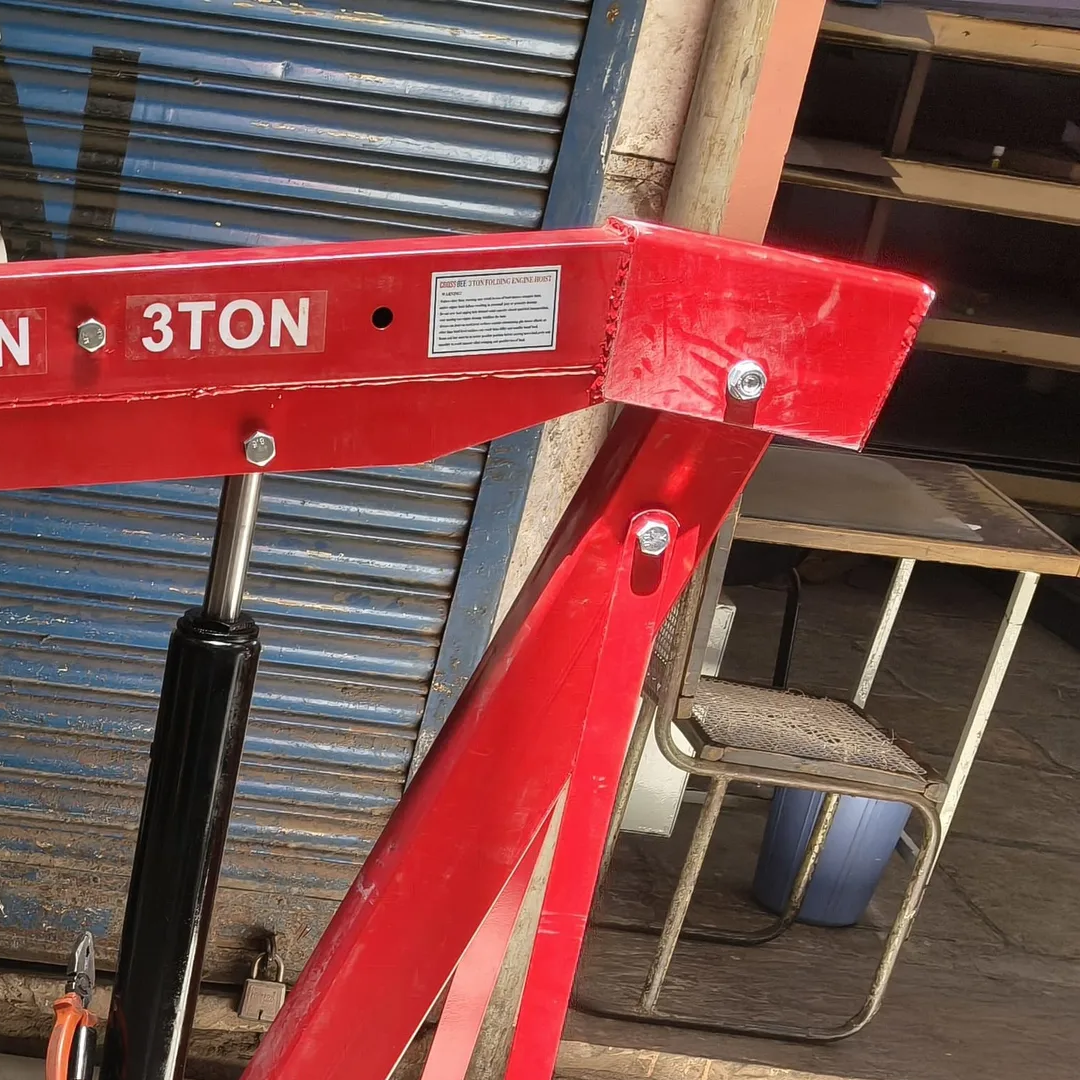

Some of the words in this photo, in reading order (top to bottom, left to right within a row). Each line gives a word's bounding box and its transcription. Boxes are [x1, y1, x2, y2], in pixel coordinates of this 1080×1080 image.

[485, 277, 511, 286] FOLDING
[511, 276, 534, 285] ENGINE
[534, 275, 552, 283] HOIST
[141, 297, 310, 353] 3TON
